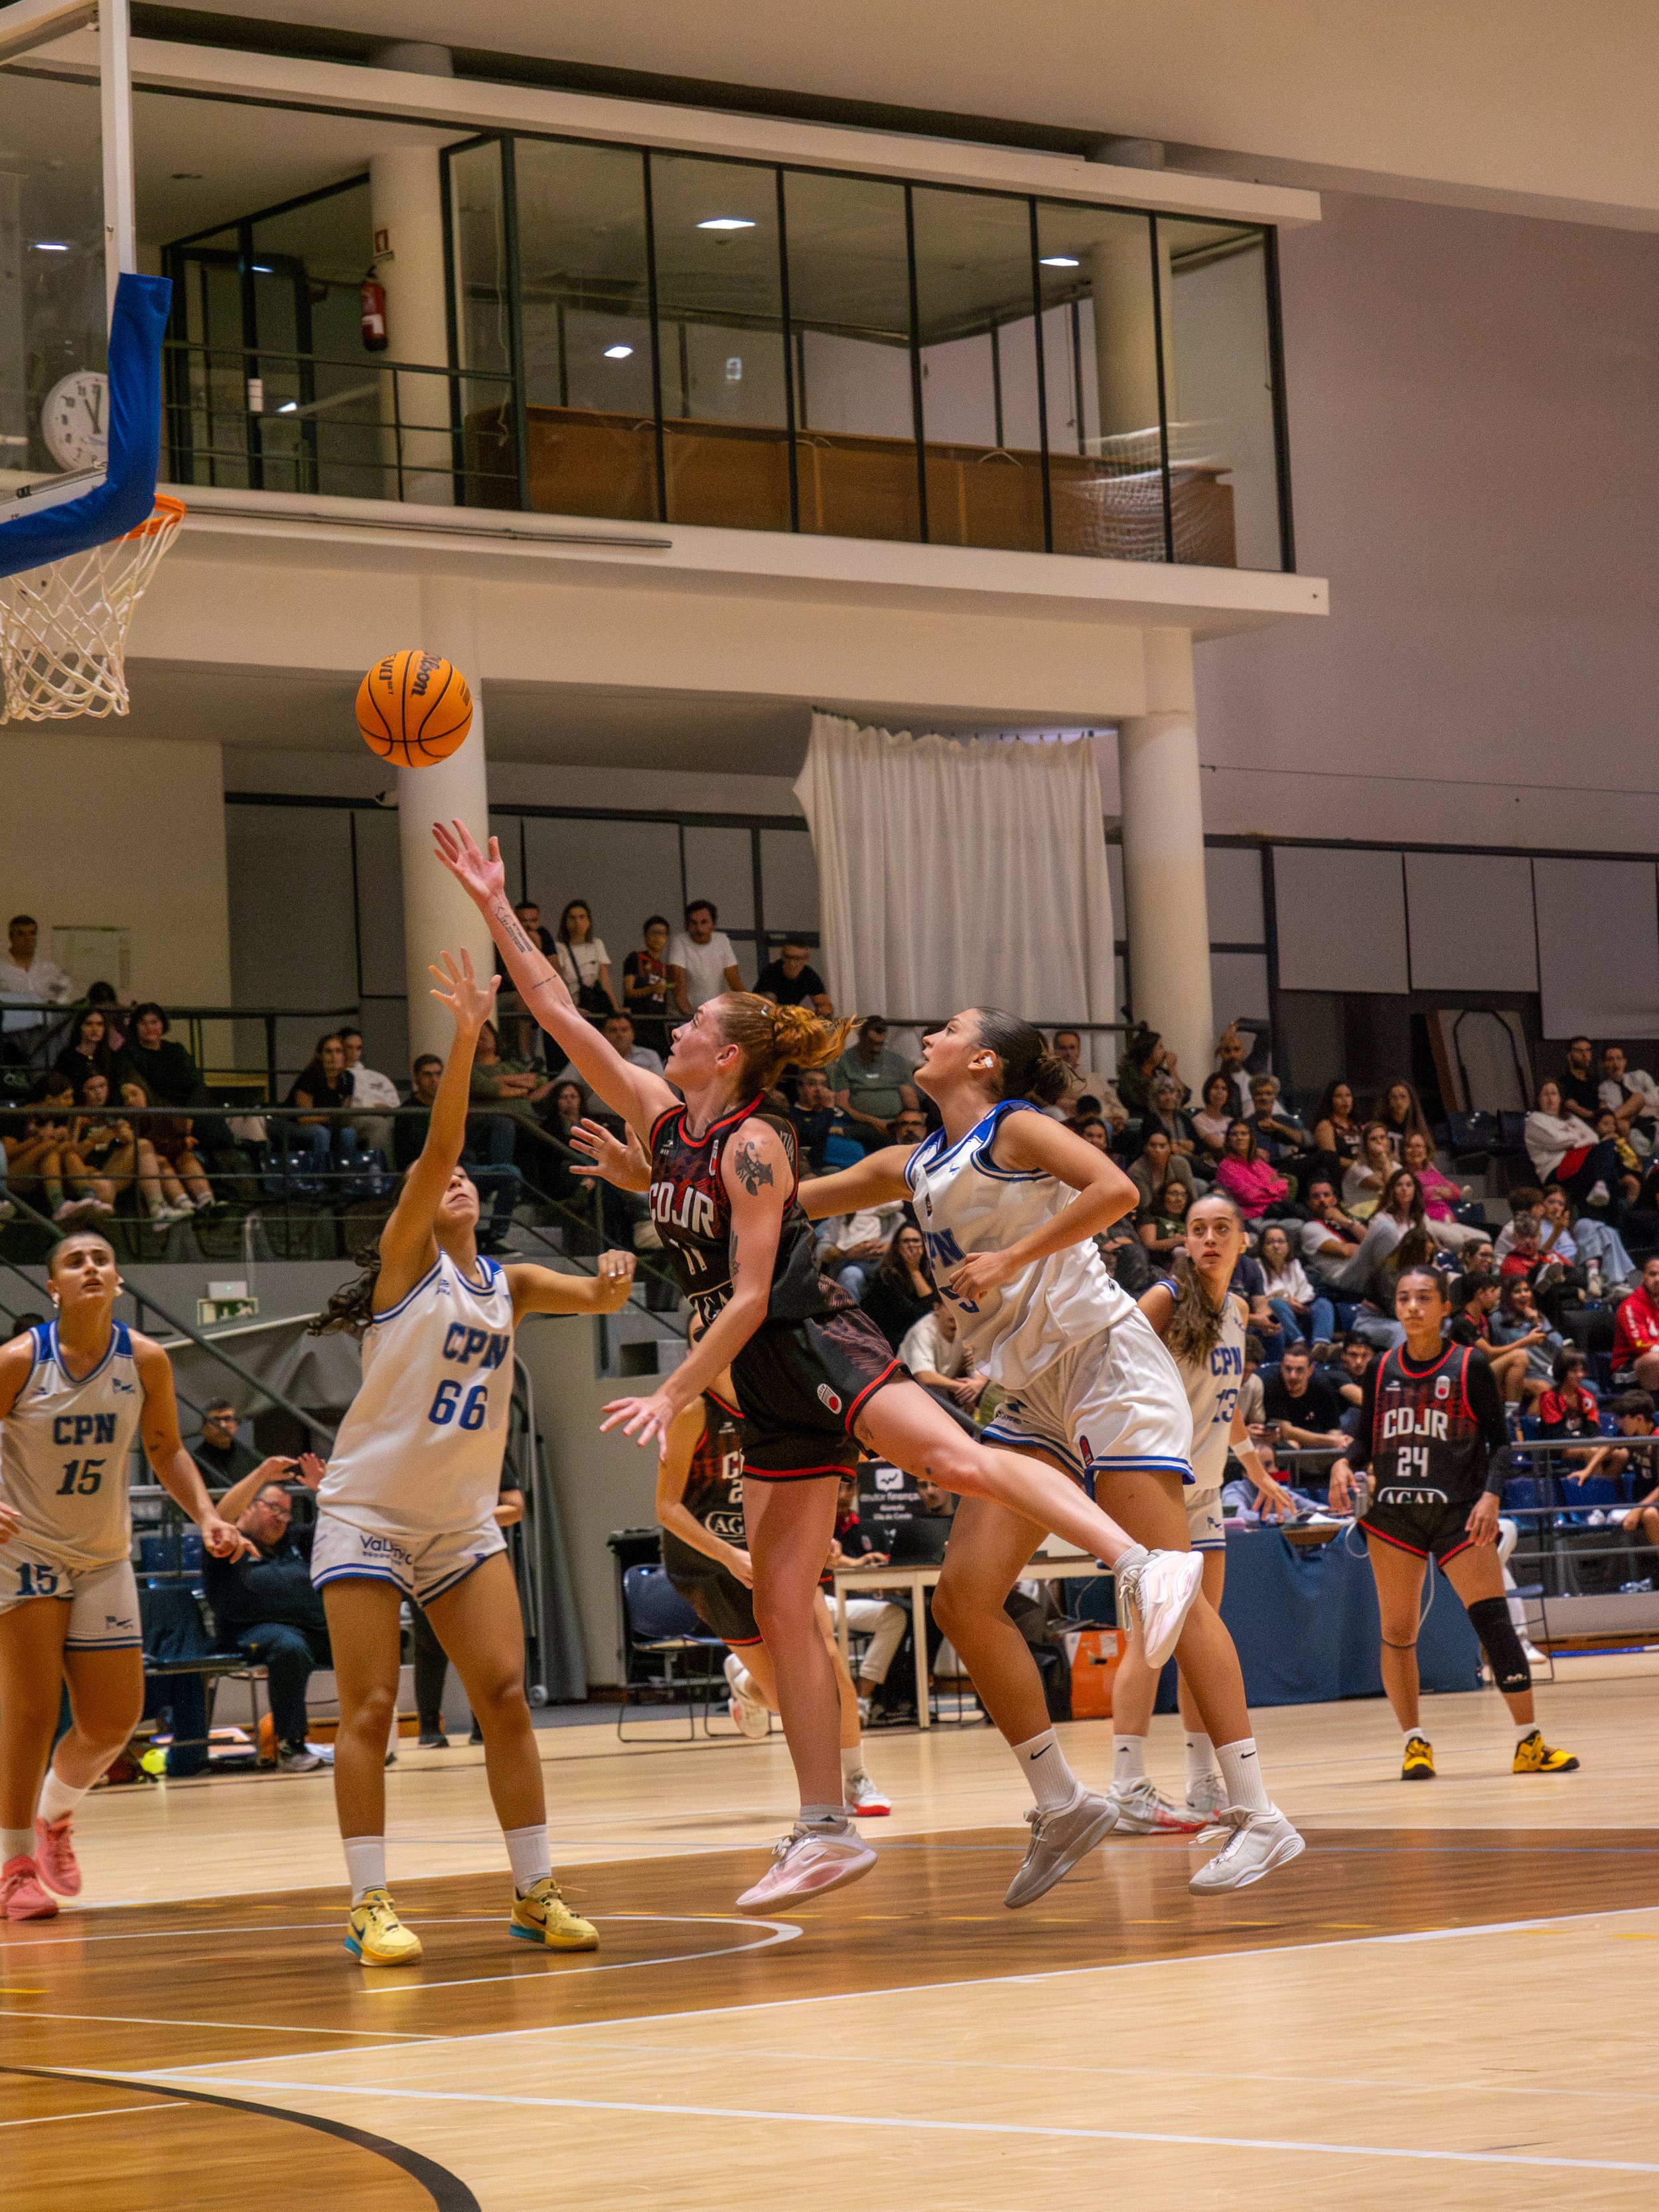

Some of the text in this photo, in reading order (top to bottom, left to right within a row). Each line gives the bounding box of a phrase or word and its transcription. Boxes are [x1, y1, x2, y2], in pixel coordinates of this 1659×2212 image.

[921, 1228, 966, 1270] PN
[442, 1321, 510, 1370] CPN
[1210, 1347, 1242, 1376] CPN
[428, 1379, 488, 1431] 66
[53, 1413, 116, 1445] CPN
[1383, 1407, 1448, 1441] CDJR
[56, 1459, 106, 1495] 15
[1397, 1446, 1429, 1477] 24
[16, 1562, 58, 1595] 15
